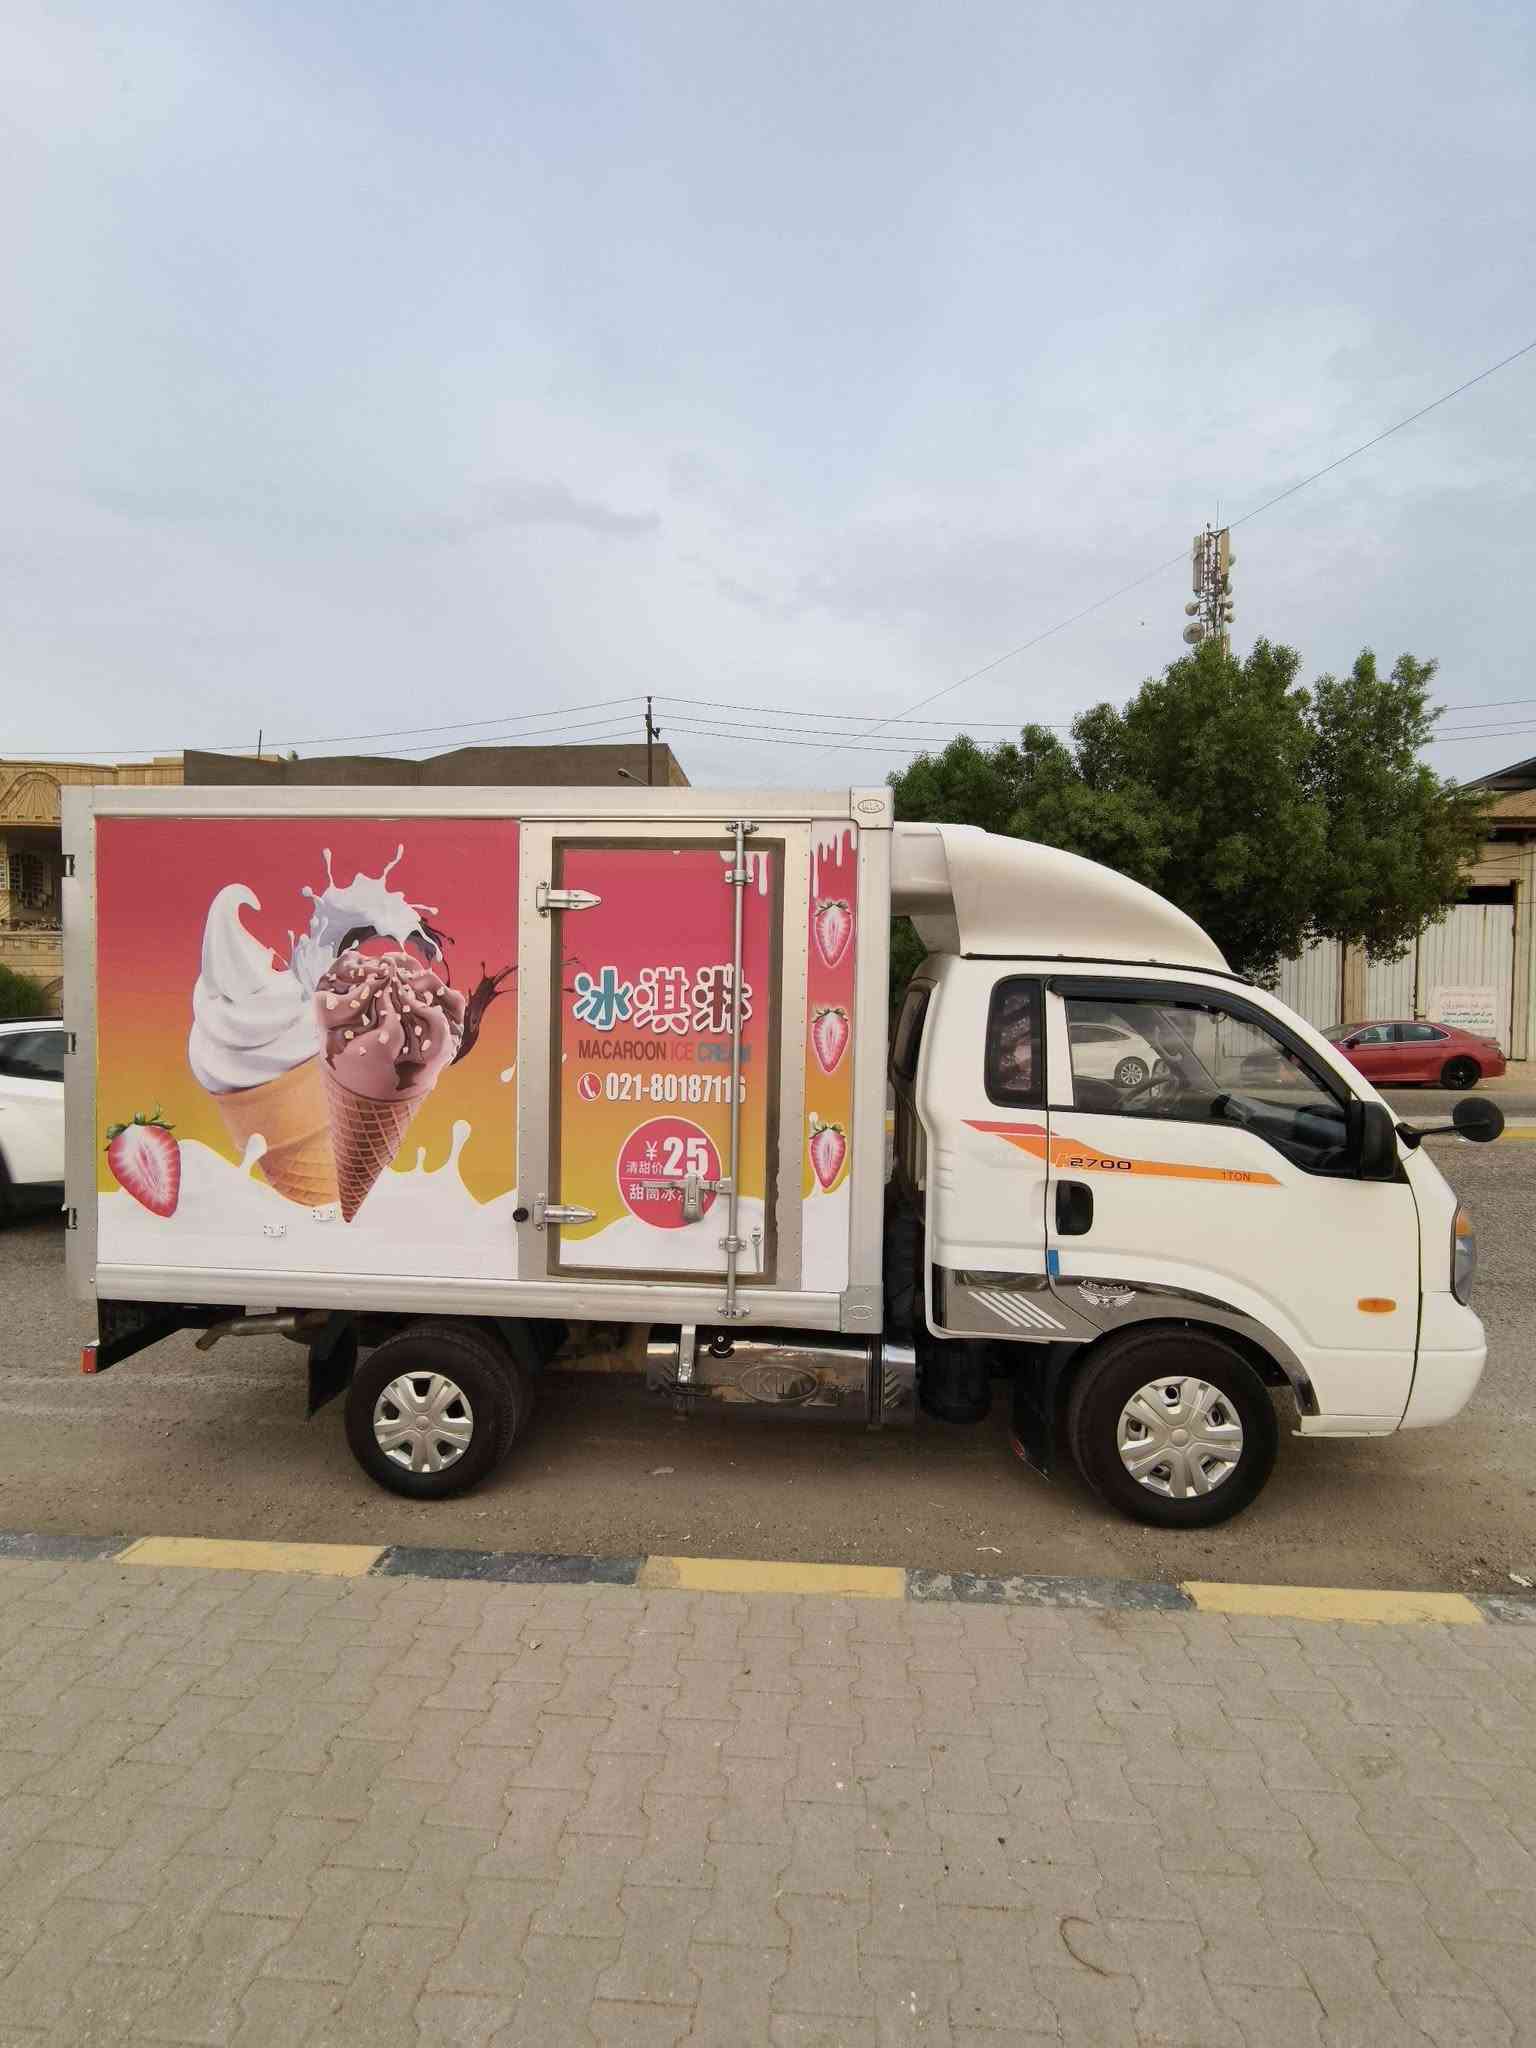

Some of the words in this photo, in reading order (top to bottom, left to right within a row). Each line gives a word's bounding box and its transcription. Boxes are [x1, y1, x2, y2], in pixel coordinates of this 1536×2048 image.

[573, 964, 752, 1035] 冰淇淋
[578, 1040, 666, 1061] MACAROON
[670, 1041, 694, 1061] ICE
